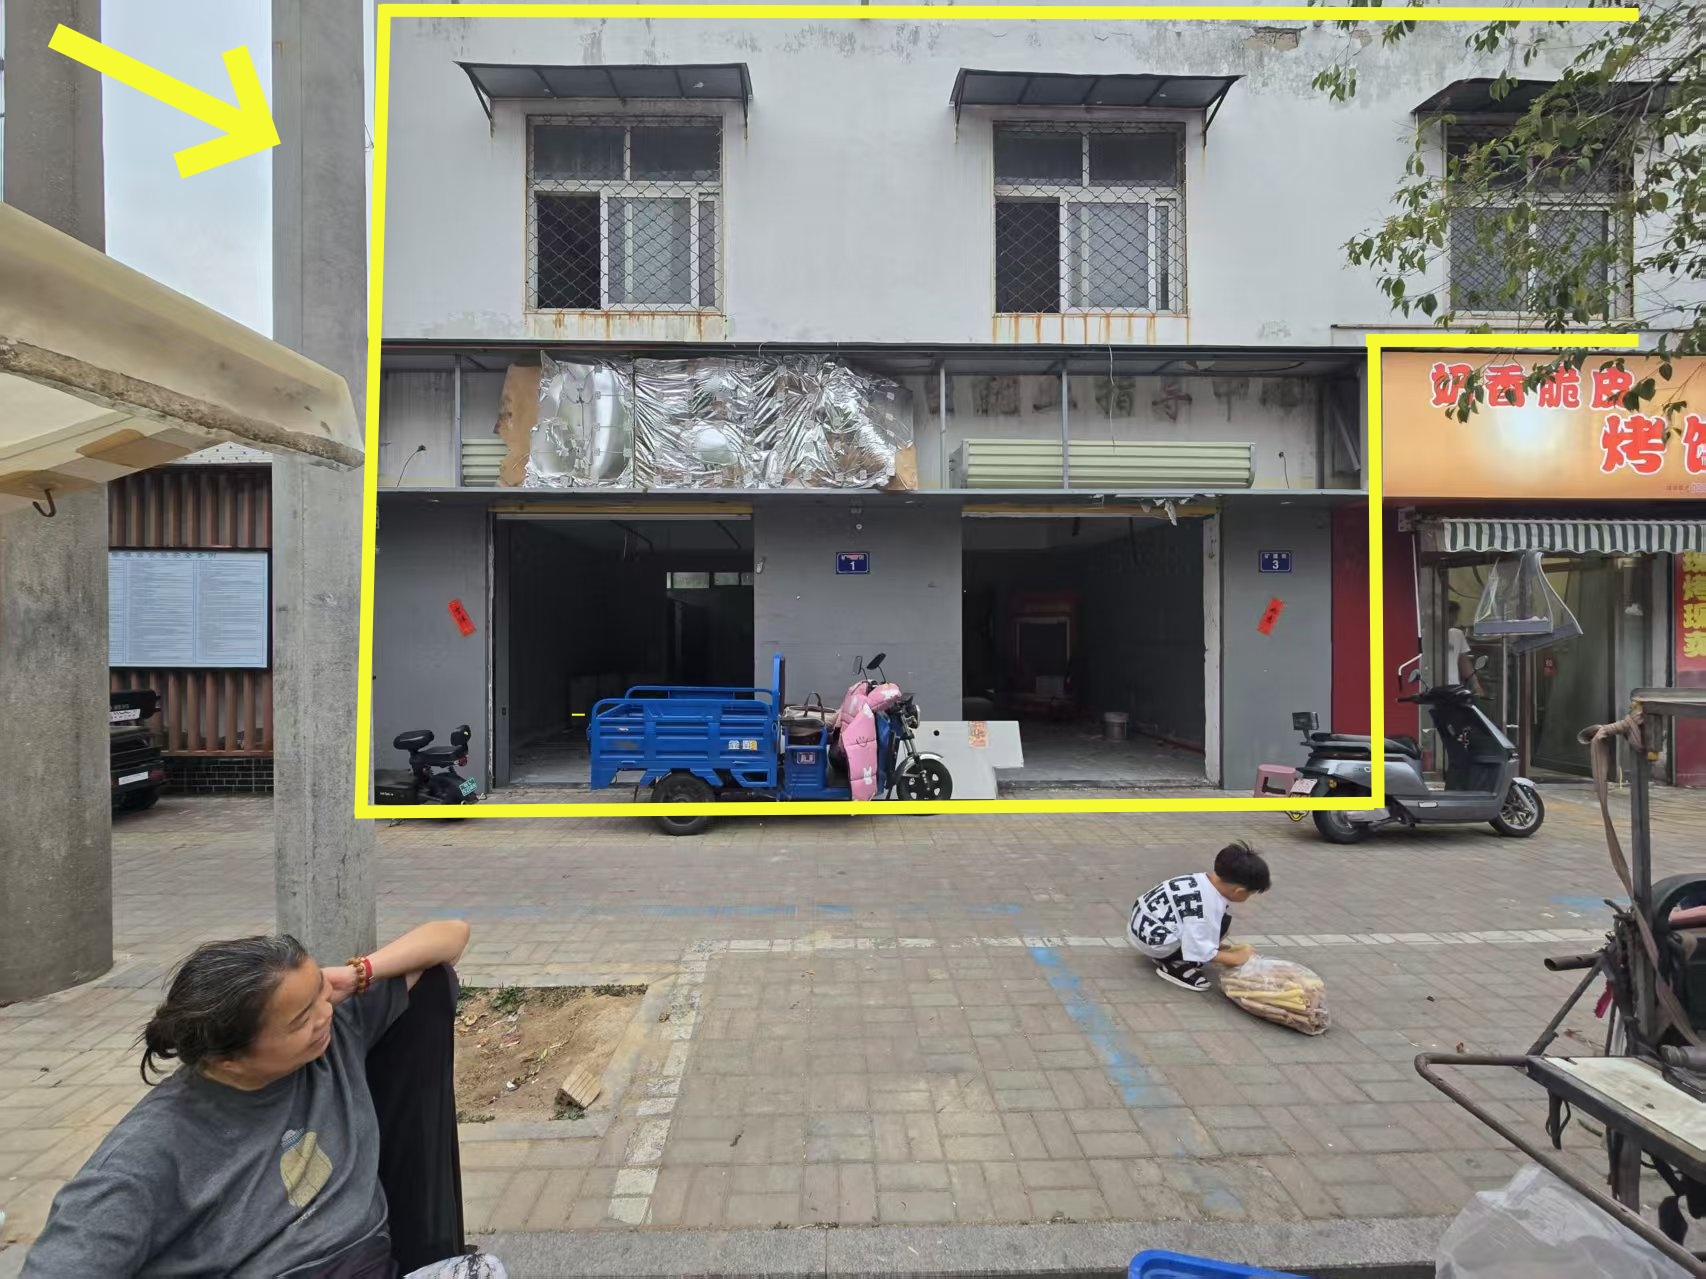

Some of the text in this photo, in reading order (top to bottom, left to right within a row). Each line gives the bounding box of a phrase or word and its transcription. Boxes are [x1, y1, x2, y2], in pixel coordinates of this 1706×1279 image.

[1431, 362, 1634, 409] 奶香脆皮
[849, 561, 855, 571] 1
[1272, 560, 1279, 570] 3
